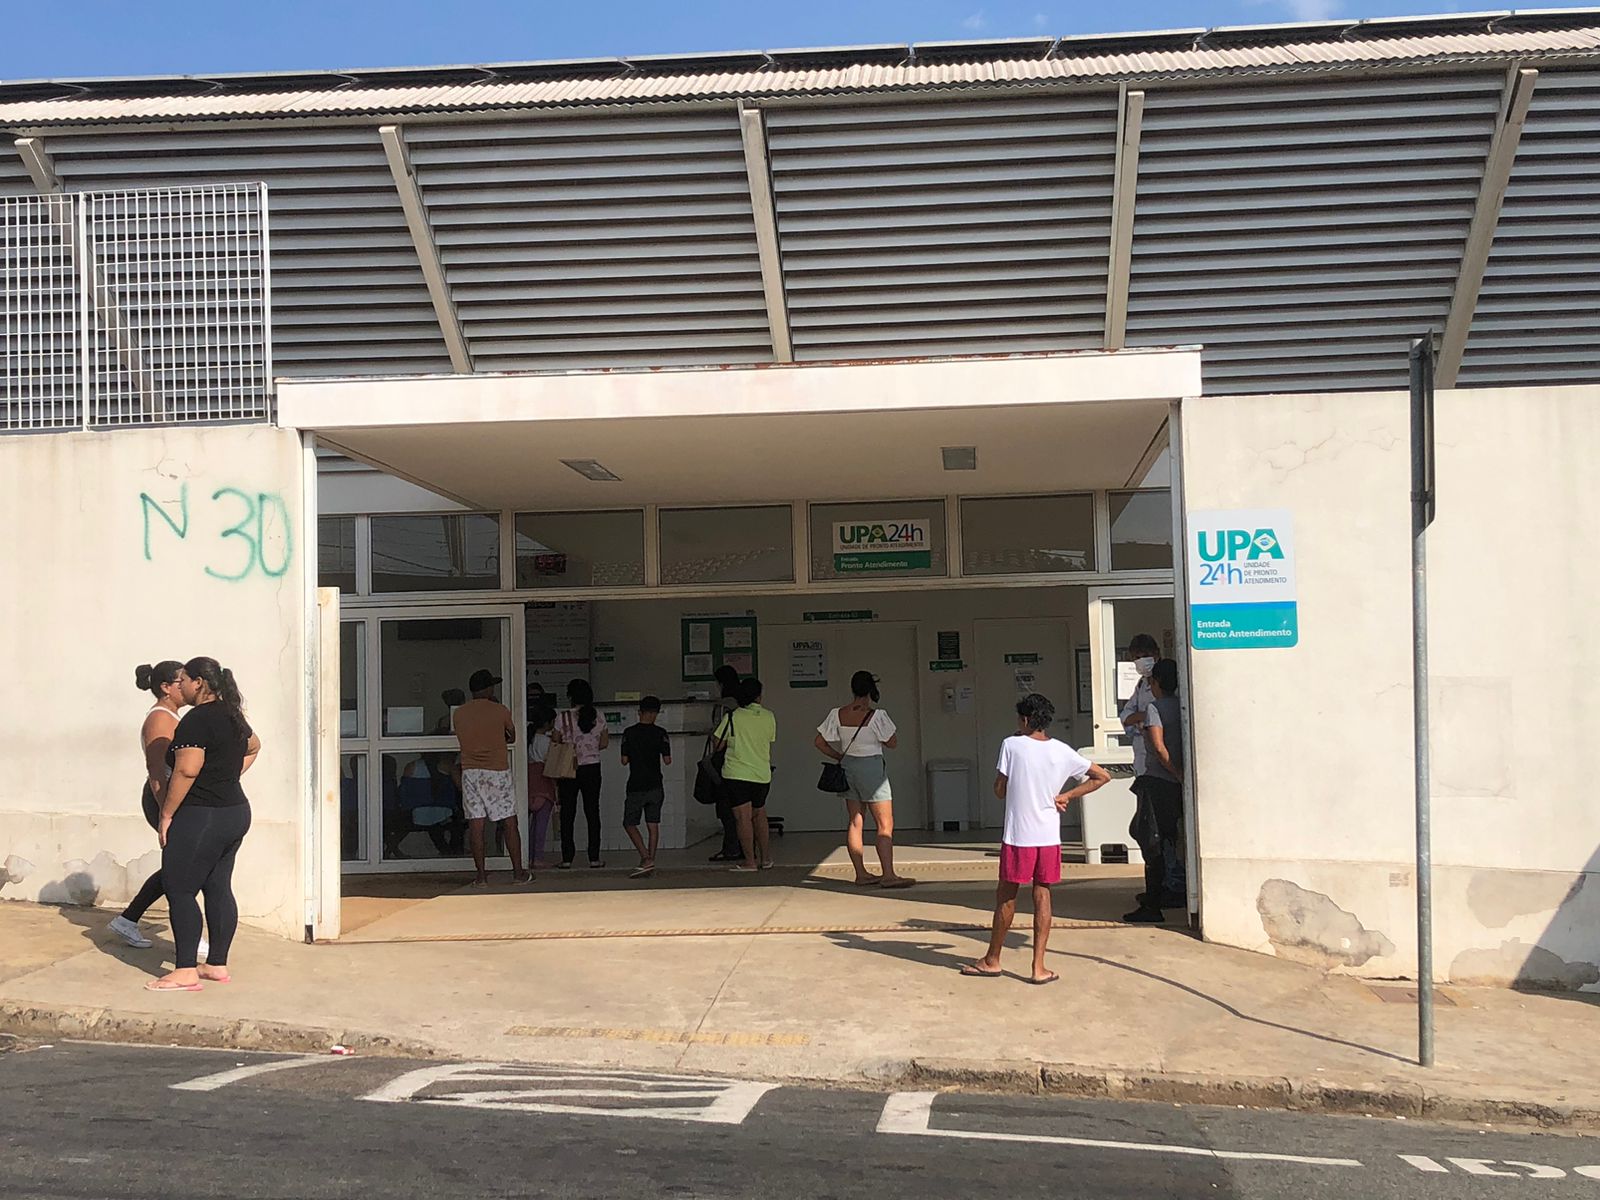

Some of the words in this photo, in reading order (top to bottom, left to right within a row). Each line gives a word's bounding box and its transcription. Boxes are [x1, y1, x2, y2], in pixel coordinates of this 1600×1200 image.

[140, 481, 189, 561] N
[204, 487, 293, 582] 30
[1197, 528, 1285, 562] UPA
[840, 561, 863, 569] Pronto
[1199, 563, 1243, 586] 24h
[1244, 577, 1287, 585] ATENDIMENTO
[1197, 619, 1231, 628] Entrada
[1197, 630, 1228, 639] Pronto
[1229, 628, 1292, 638] Antendimento
